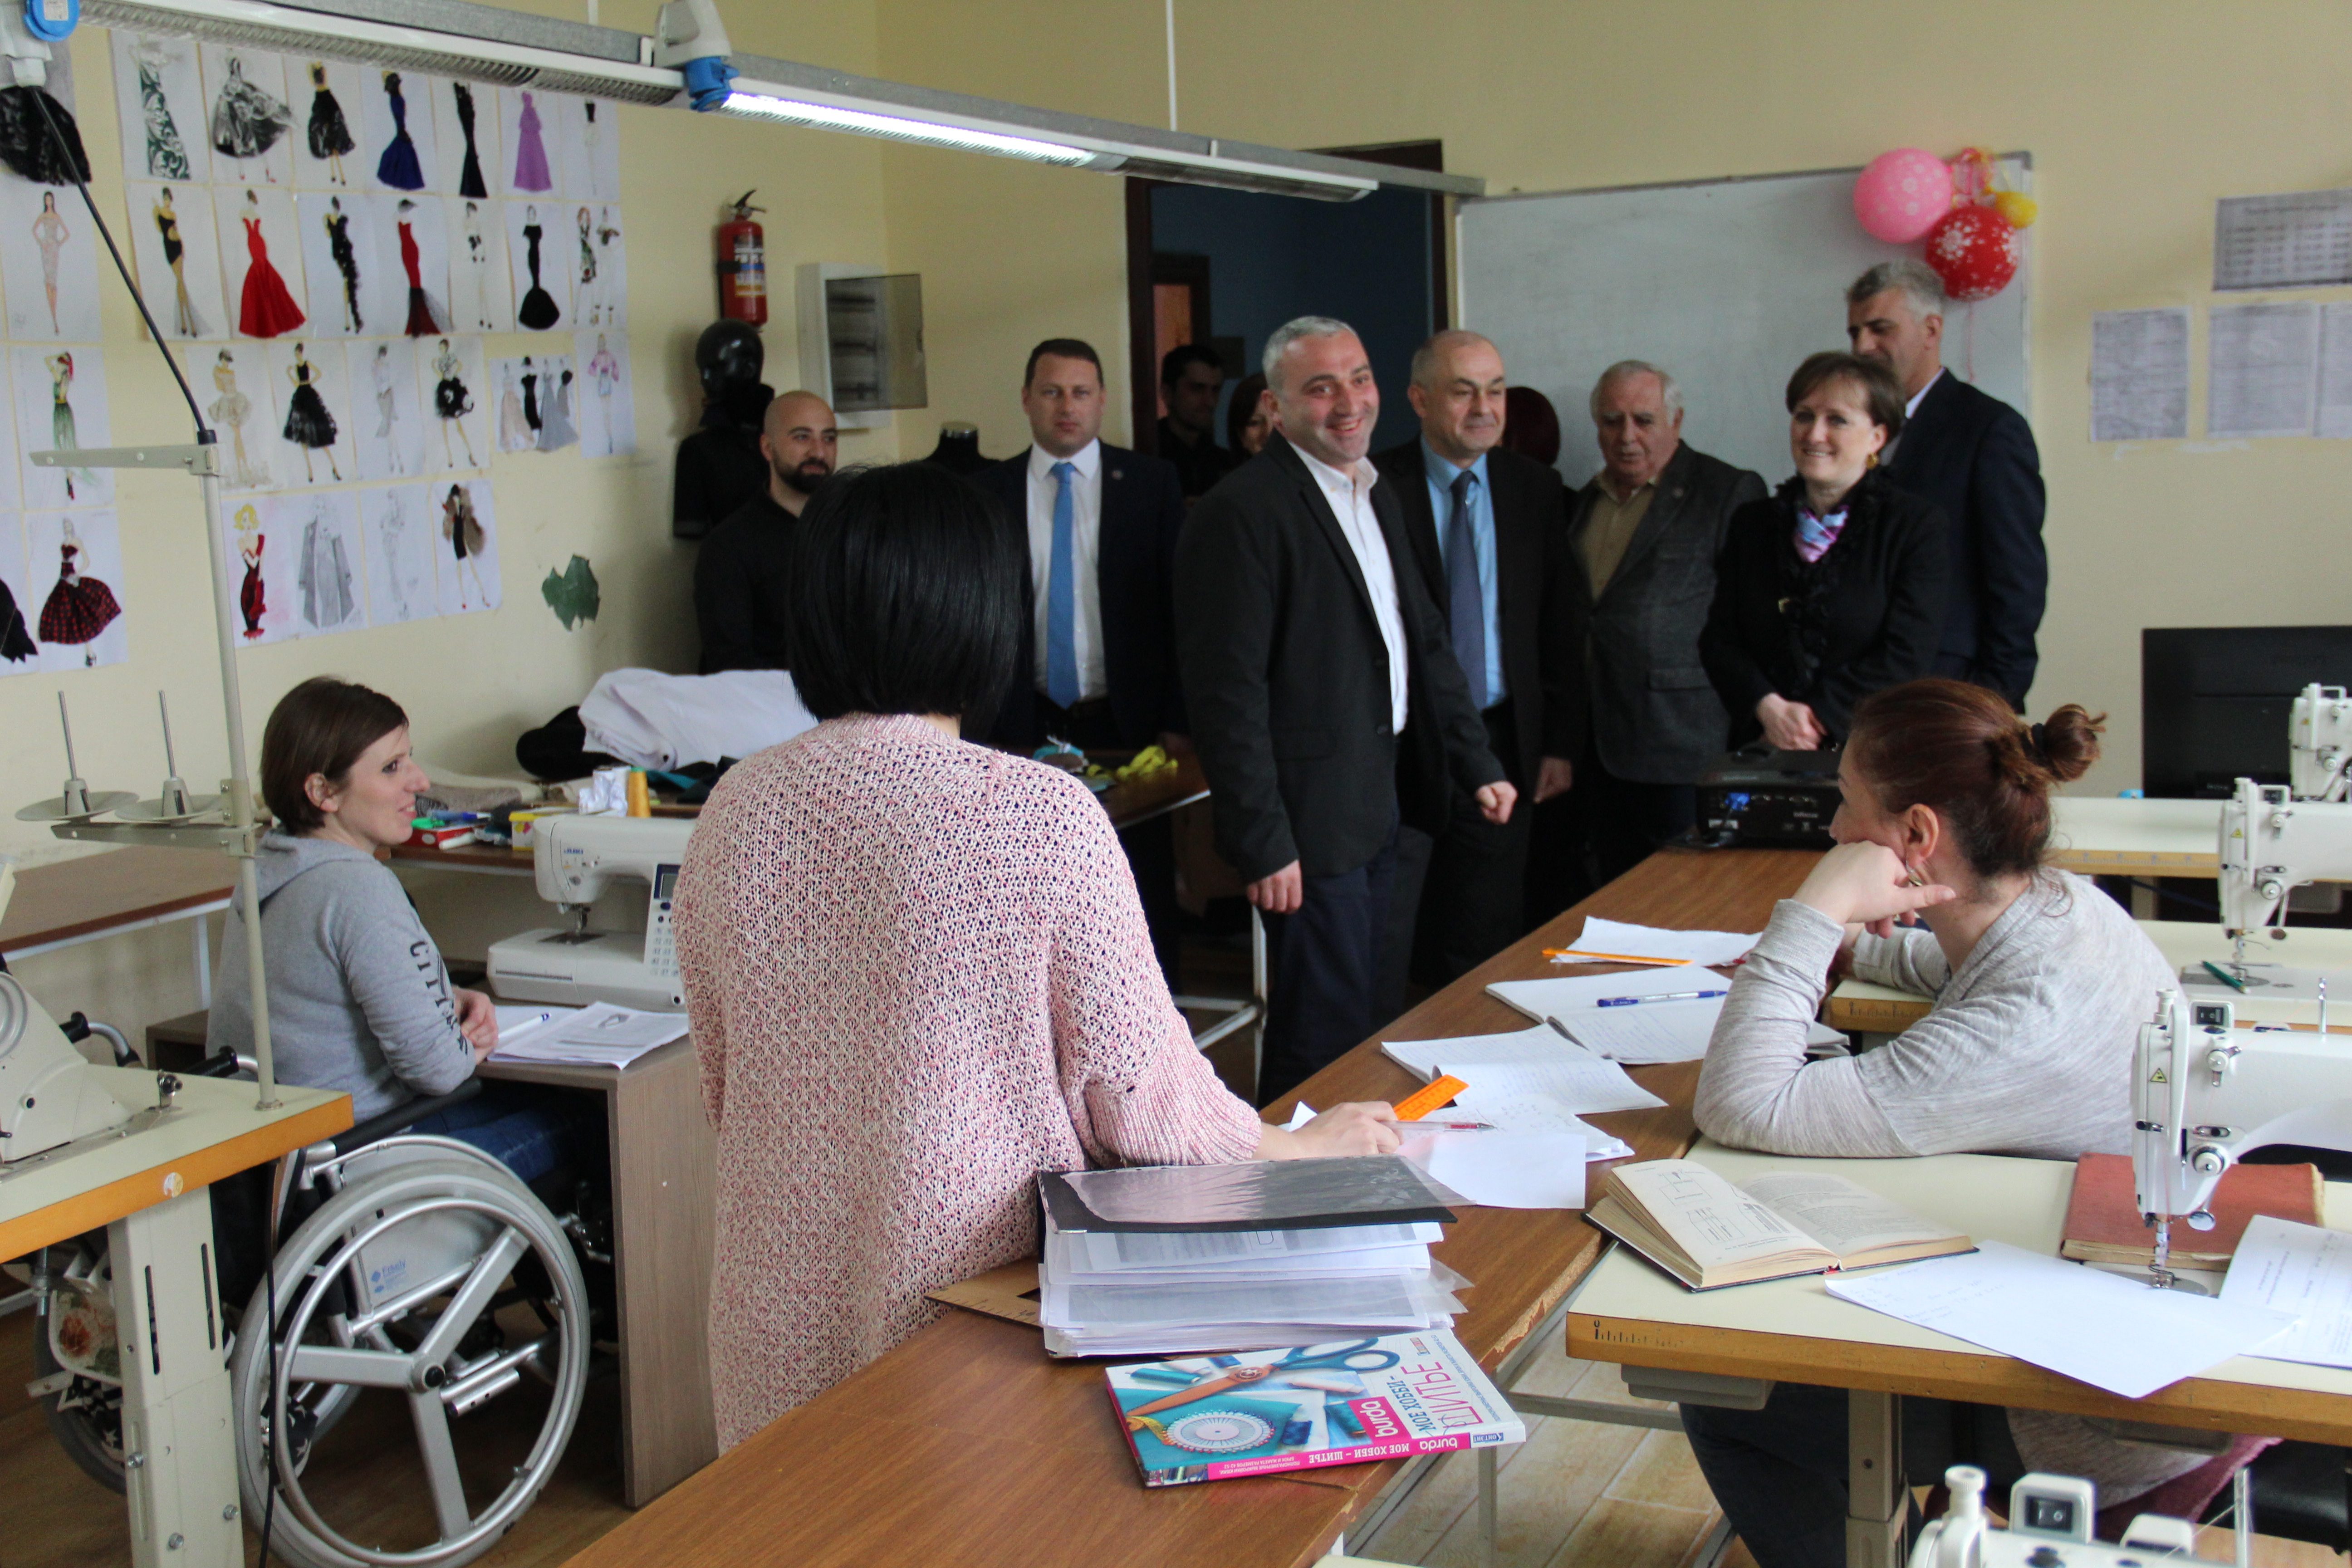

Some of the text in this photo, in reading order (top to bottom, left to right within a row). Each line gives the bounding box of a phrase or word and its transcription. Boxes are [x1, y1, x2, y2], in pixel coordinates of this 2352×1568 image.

[1386, 1380, 1422, 1411] ХОББИ
[1400, 1362, 1483, 1428] ШИТЬЕ
[1360, 1401, 1398, 1438] burda
[1407, 1411, 1436, 1431] МОЕ
[1353, 1446, 1387, 1458] ХОББИ
[1388, 1443, 1409, 1454] МОЕ
[1419, 1436, 1458, 1452] burda
[1258, 1460, 1300, 1470] ПОЛНОРАЗМЕРНЫЕ
[1308, 1451, 1343, 1463] ШИТЬЕ
